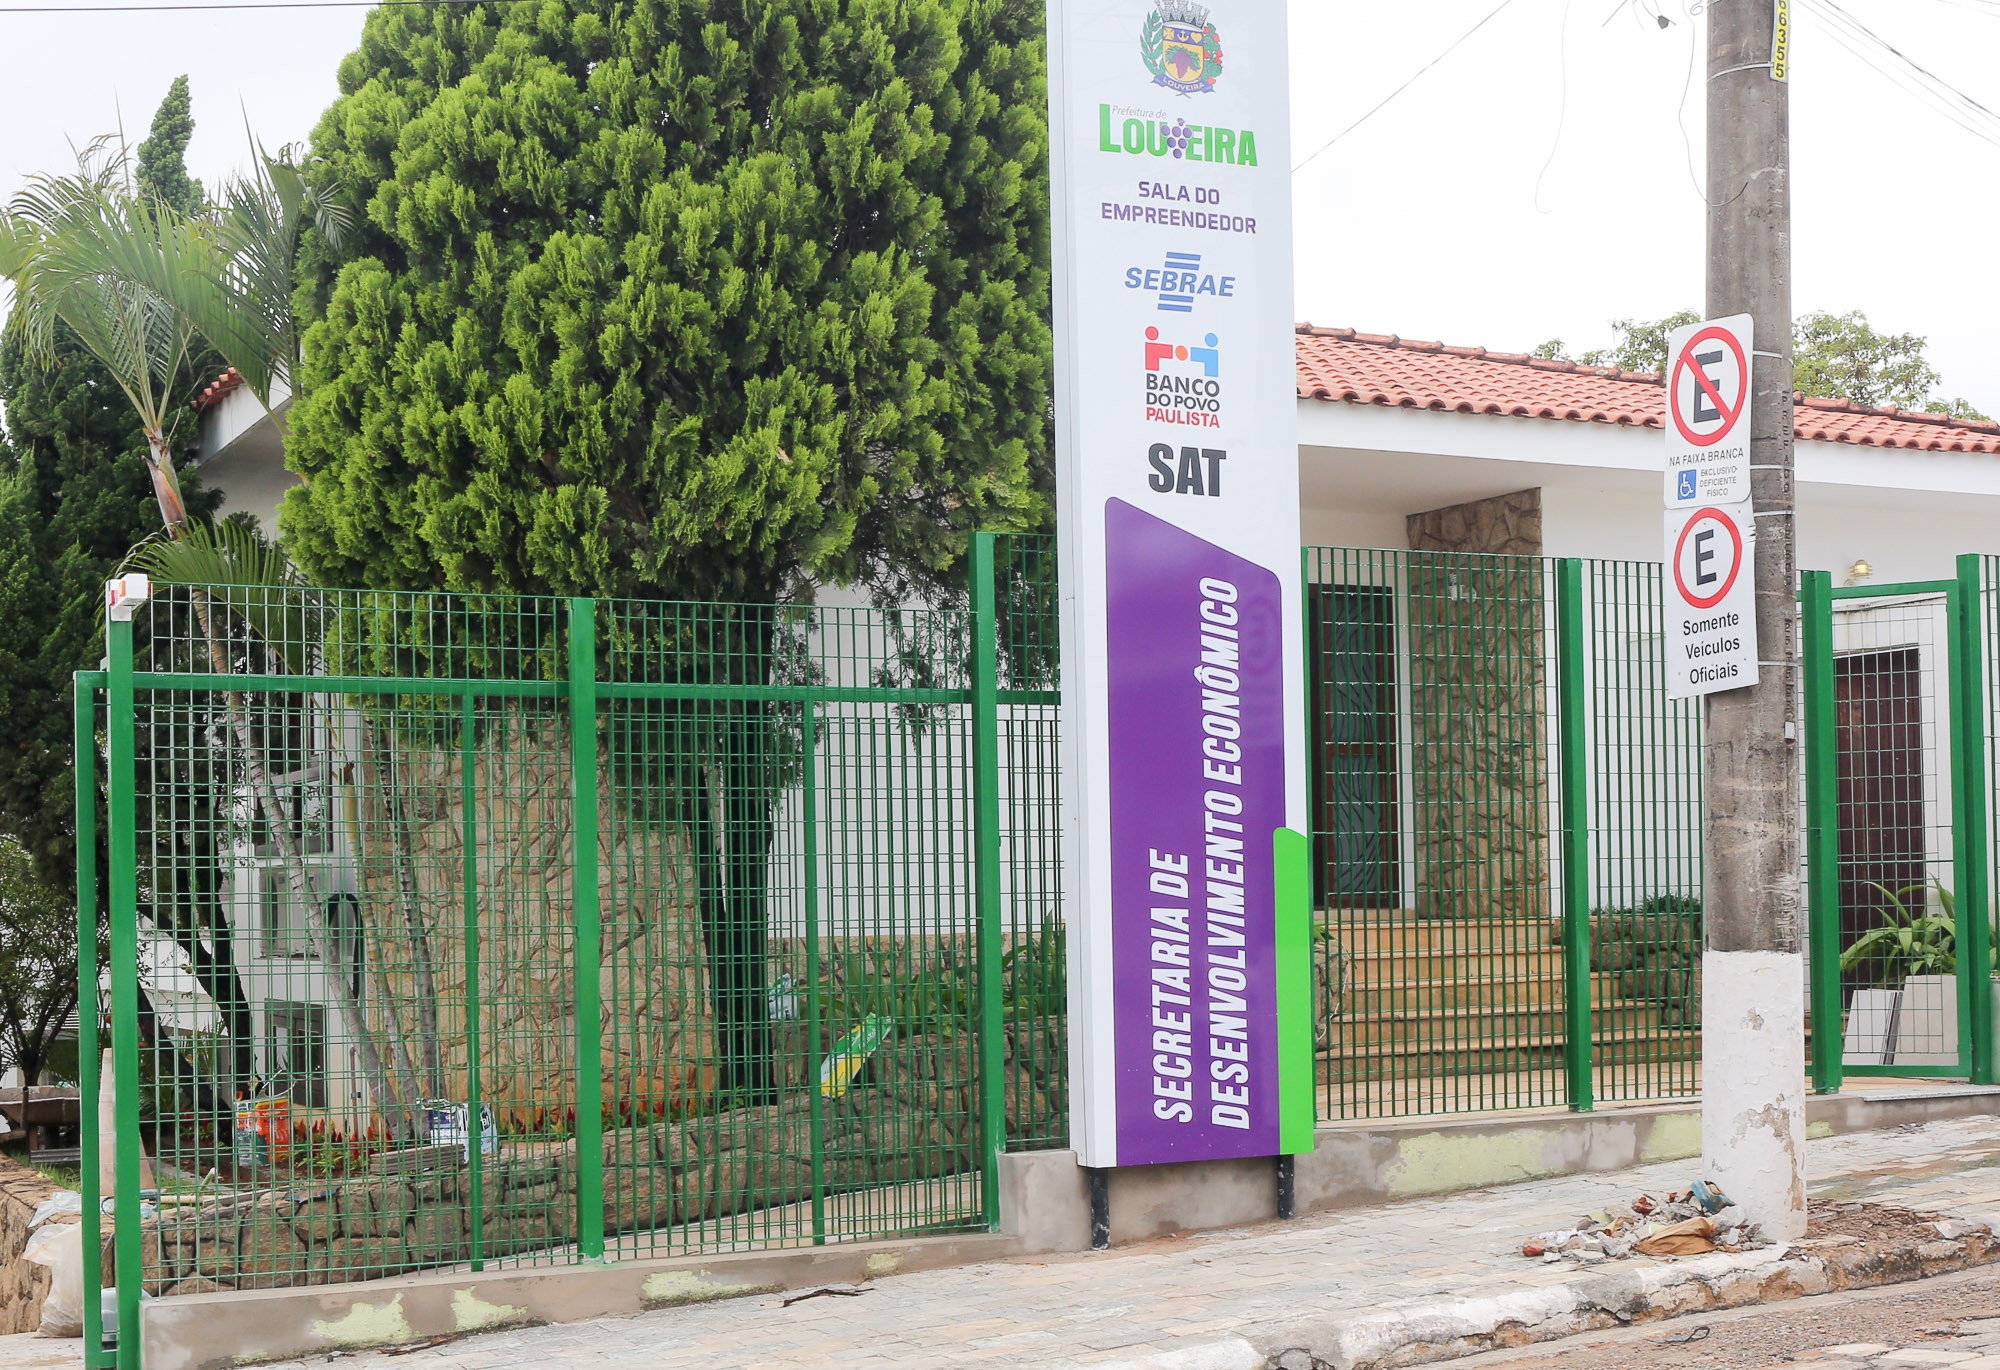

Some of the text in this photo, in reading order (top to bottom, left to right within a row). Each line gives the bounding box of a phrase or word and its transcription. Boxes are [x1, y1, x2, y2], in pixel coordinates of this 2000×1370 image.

[1162, 77, 1205, 91] LOUVEIRA
[1112, 105, 1167, 119] Prefeitura de
[1138, 181, 1220, 205] SALA DO
[1101, 202, 1256, 234] EMPREENDEDOR
[1125, 267, 1235, 297] SEBRAE
[1146, 373, 1220, 398] BANCO
[1146, 392, 1220, 412] DO POVO
[1146, 407, 1220, 429] PAULISTA
[1669, 447, 1744, 467] NA FAIXA BRANCA
[1148, 443, 1227, 497] SAT
[1700, 465, 1736, 477] EXCLUSIVO
[1699, 476, 1737, 488] DEFICIENTE
[1695, 529, 1717, 586] E
[1683, 612, 1739, 636] Somente
[1685, 637, 1740, 660] Veículos
[1689, 663, 1739, 684] Oficiais
[1193, 576, 1251, 1131] DESENVOLVIMENTO ECONÔMICO
[1149, 848, 1194, 1125] SECRETARIA DE
